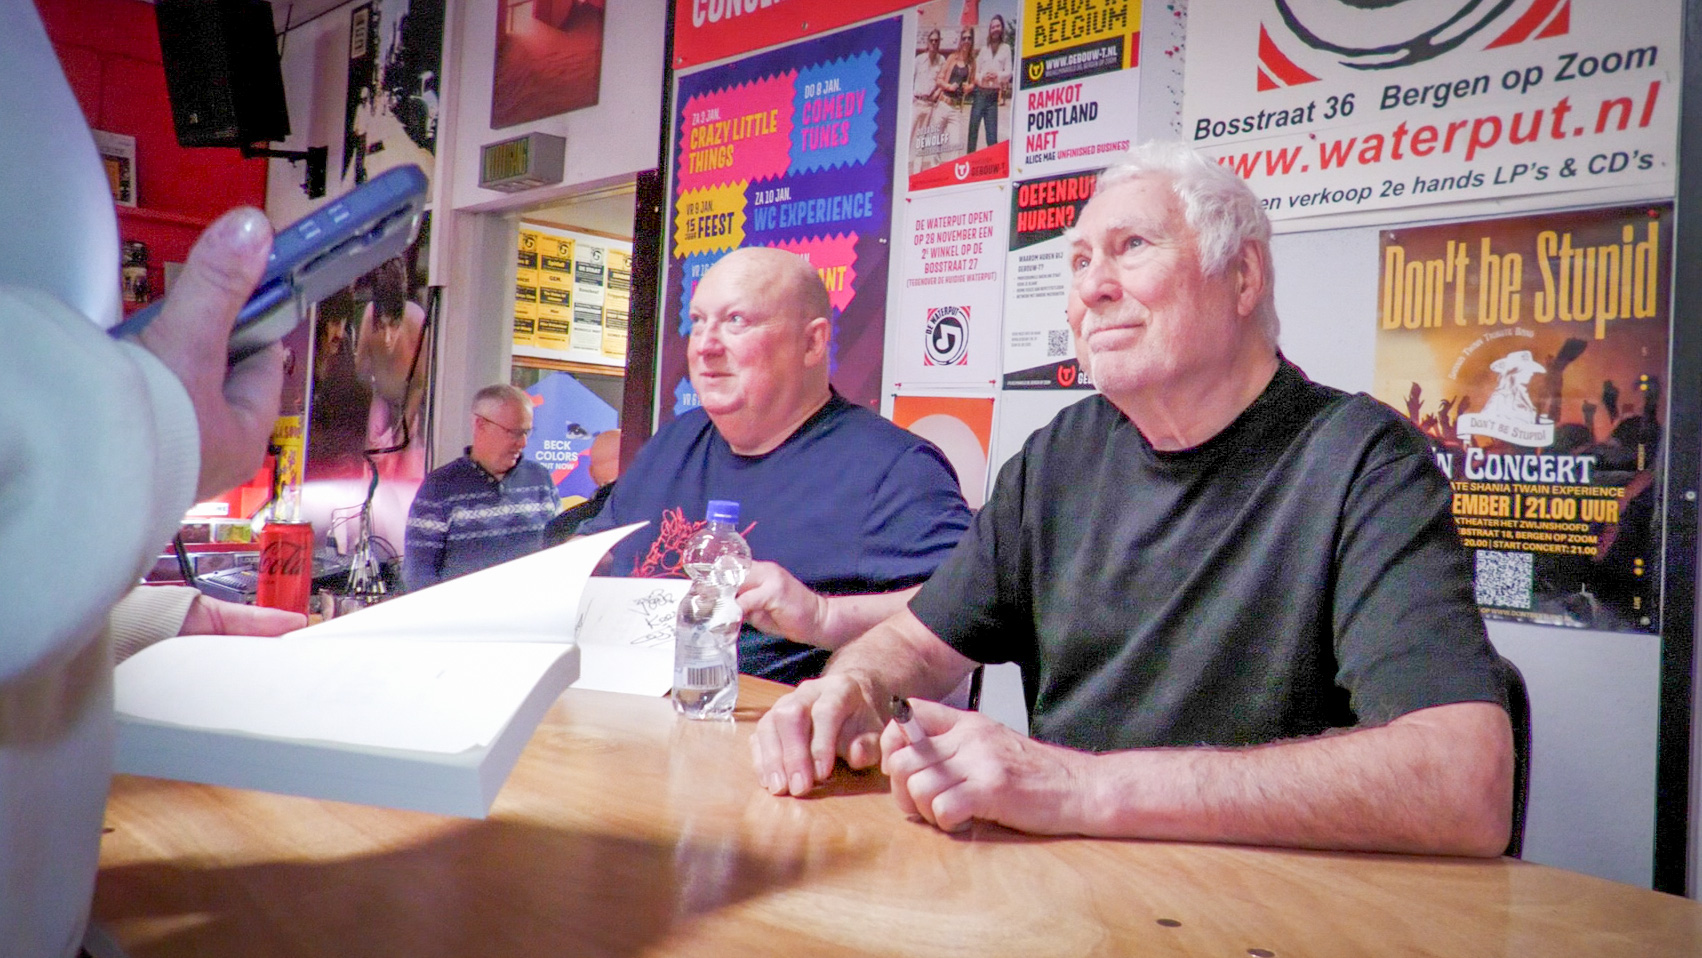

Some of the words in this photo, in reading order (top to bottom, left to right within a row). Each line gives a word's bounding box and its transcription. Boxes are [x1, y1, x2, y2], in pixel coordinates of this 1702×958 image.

[1034, 4, 1127, 47] BELGIUM
[1045, 45, 1117, 70] WWW.GEBOUW-T.NL
[804, 84, 815, 99] DO
[816, 82, 822, 95] 8
[1028, 83, 1083, 111] RAMKOT
[1194, 101, 1316, 141] Bosstraat
[1323, 93, 1355, 120] 36
[1379, 74, 1490, 110] Bergen
[1501, 65, 1543, 94] op
[1554, 45, 1658, 82] Zoom
[802, 88, 867, 125] COMEDY
[1027, 101, 1098, 132] PORTLAND
[690, 120, 731, 150] CRAZY
[732, 109, 778, 141] LITTLE
[802, 120, 850, 152] TUNES
[915, 133, 950, 149] DEWOLFF
[1026, 130, 1059, 153] NAFT
[1218, 81, 1661, 180] ww.waterput.nl
[689, 144, 734, 174] THINGS
[1025, 153, 1042, 164] ALICE
[1043, 151, 1056, 162] MAE
[1057, 145, 1095, 160] UNFINISHED
[1289, 187, 1372, 208] verkoop
[1379, 179, 1405, 198] 2e
[1412, 170, 1485, 194] hands
[1559, 158, 1577, 178] &
[755, 191, 764, 206] ZA
[765, 189, 775, 204] 10
[775, 187, 791, 203] JAN.
[754, 204, 776, 232] WC
[779, 191, 874, 229] EXPERIENCE
[916, 219, 925, 231] DE
[927, 213, 966, 230] WATERPUT
[968, 210, 993, 225] OPENT
[1017, 205, 1075, 232] HUREN?
[686, 218, 695, 232] 15
[698, 212, 734, 238] FEEST
[914, 234, 924, 246] OP
[925, 232, 935, 244] 28
[937, 228, 977, 243] NOVEMBER
[979, 225, 993, 239] EEN
[930, 245, 959, 258] WINKEL
[961, 243, 971, 255] OP
[973, 242, 983, 254] DE
[924, 259, 967, 274] BOSSTRAAT
[968, 258, 978, 270] 27
[1382, 240, 1470, 330] Don't
[1478, 237, 1522, 326] be
[1534, 222, 1659, 340] Stupid
[535, 450, 579, 461] COLORS
[543, 440, 572, 450] BECK
[1464, 447, 1597, 483] CONCERT
[1470, 483, 1511, 493] SHANIA
[1513, 484, 1549, 495] TWAIN
[1552, 486, 1625, 498] EXPERIENCE
[1452, 493, 1510, 518] EMBER
[1525, 497, 1576, 520] 21.00
[1581, 499, 1620, 523] UUR
[1500, 520, 1518, 528] HET
[1463, 538, 1488, 547] 20.00
[1492, 540, 1521, 550] START
[1571, 545, 1598, 555] 21.00
[1515, 532, 1551, 541] BERGEN
[1553, 533, 1566, 542] OP
[1567, 534, 1598, 544] ZOOM
